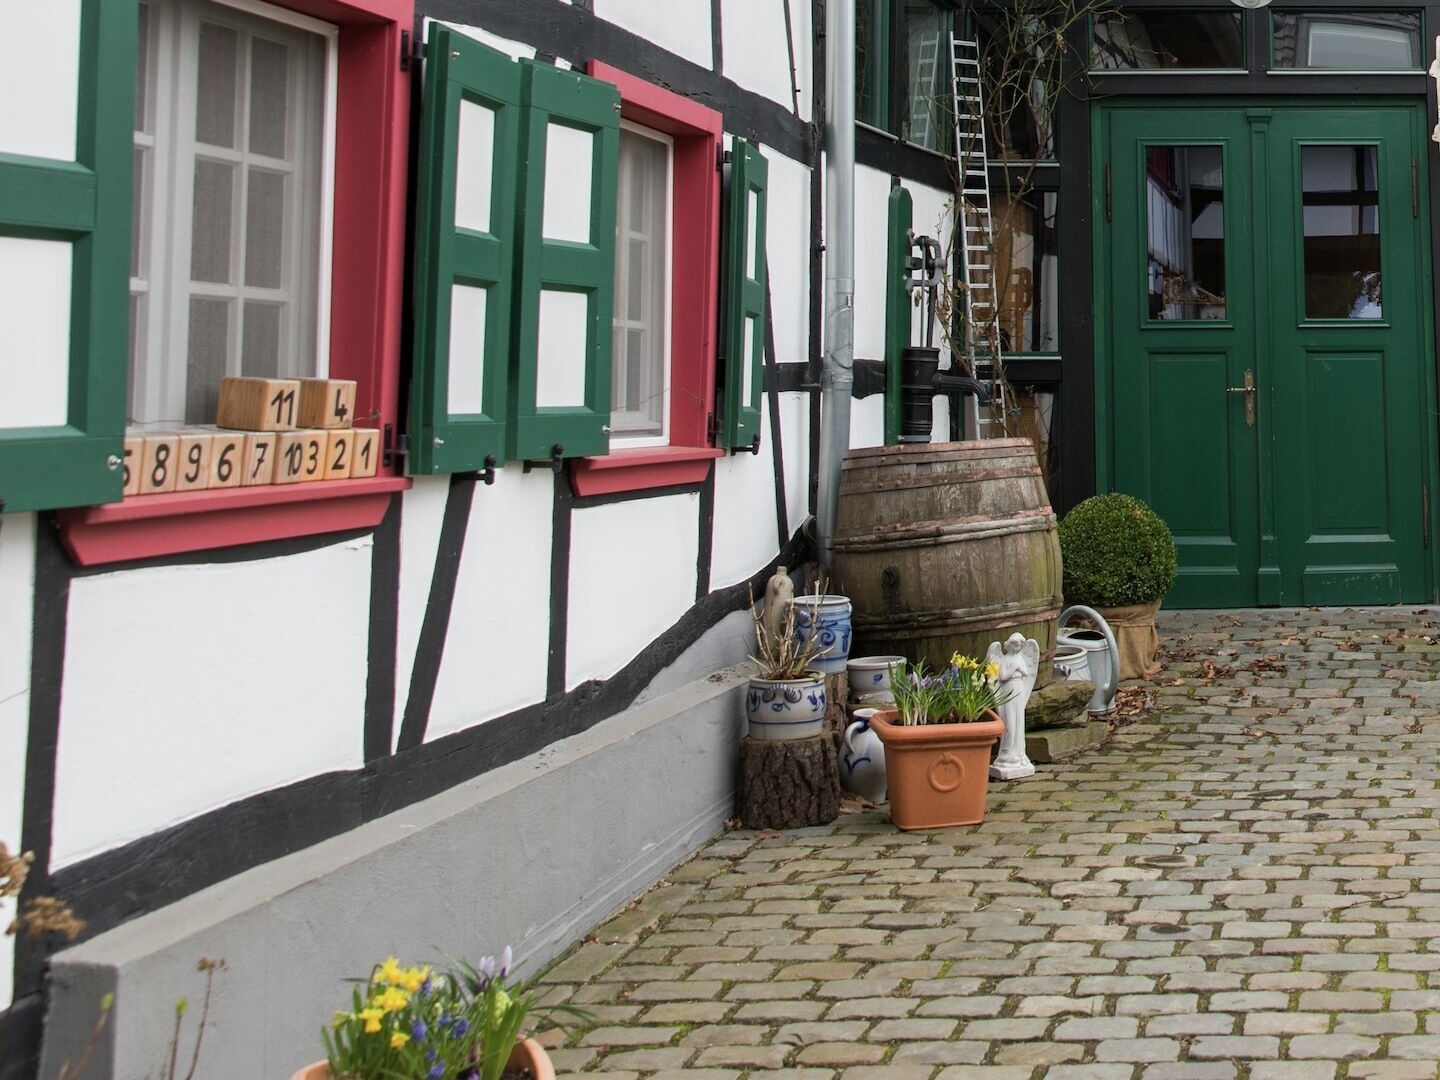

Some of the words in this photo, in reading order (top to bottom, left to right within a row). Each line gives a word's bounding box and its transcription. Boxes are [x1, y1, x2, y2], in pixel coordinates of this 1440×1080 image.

[271, 389, 295, 425] 11
[334, 388, 347, 422] 4
[152, 443, 170, 487] 8
[185, 443, 202, 483] 9
[217, 443, 236, 482] 6
[252, 442, 268, 478] 7
[284, 441, 303, 476] 10
[306, 440, 319, 475] 3
[331, 438, 346, 470] 2
[361, 437, 372, 470] 1
